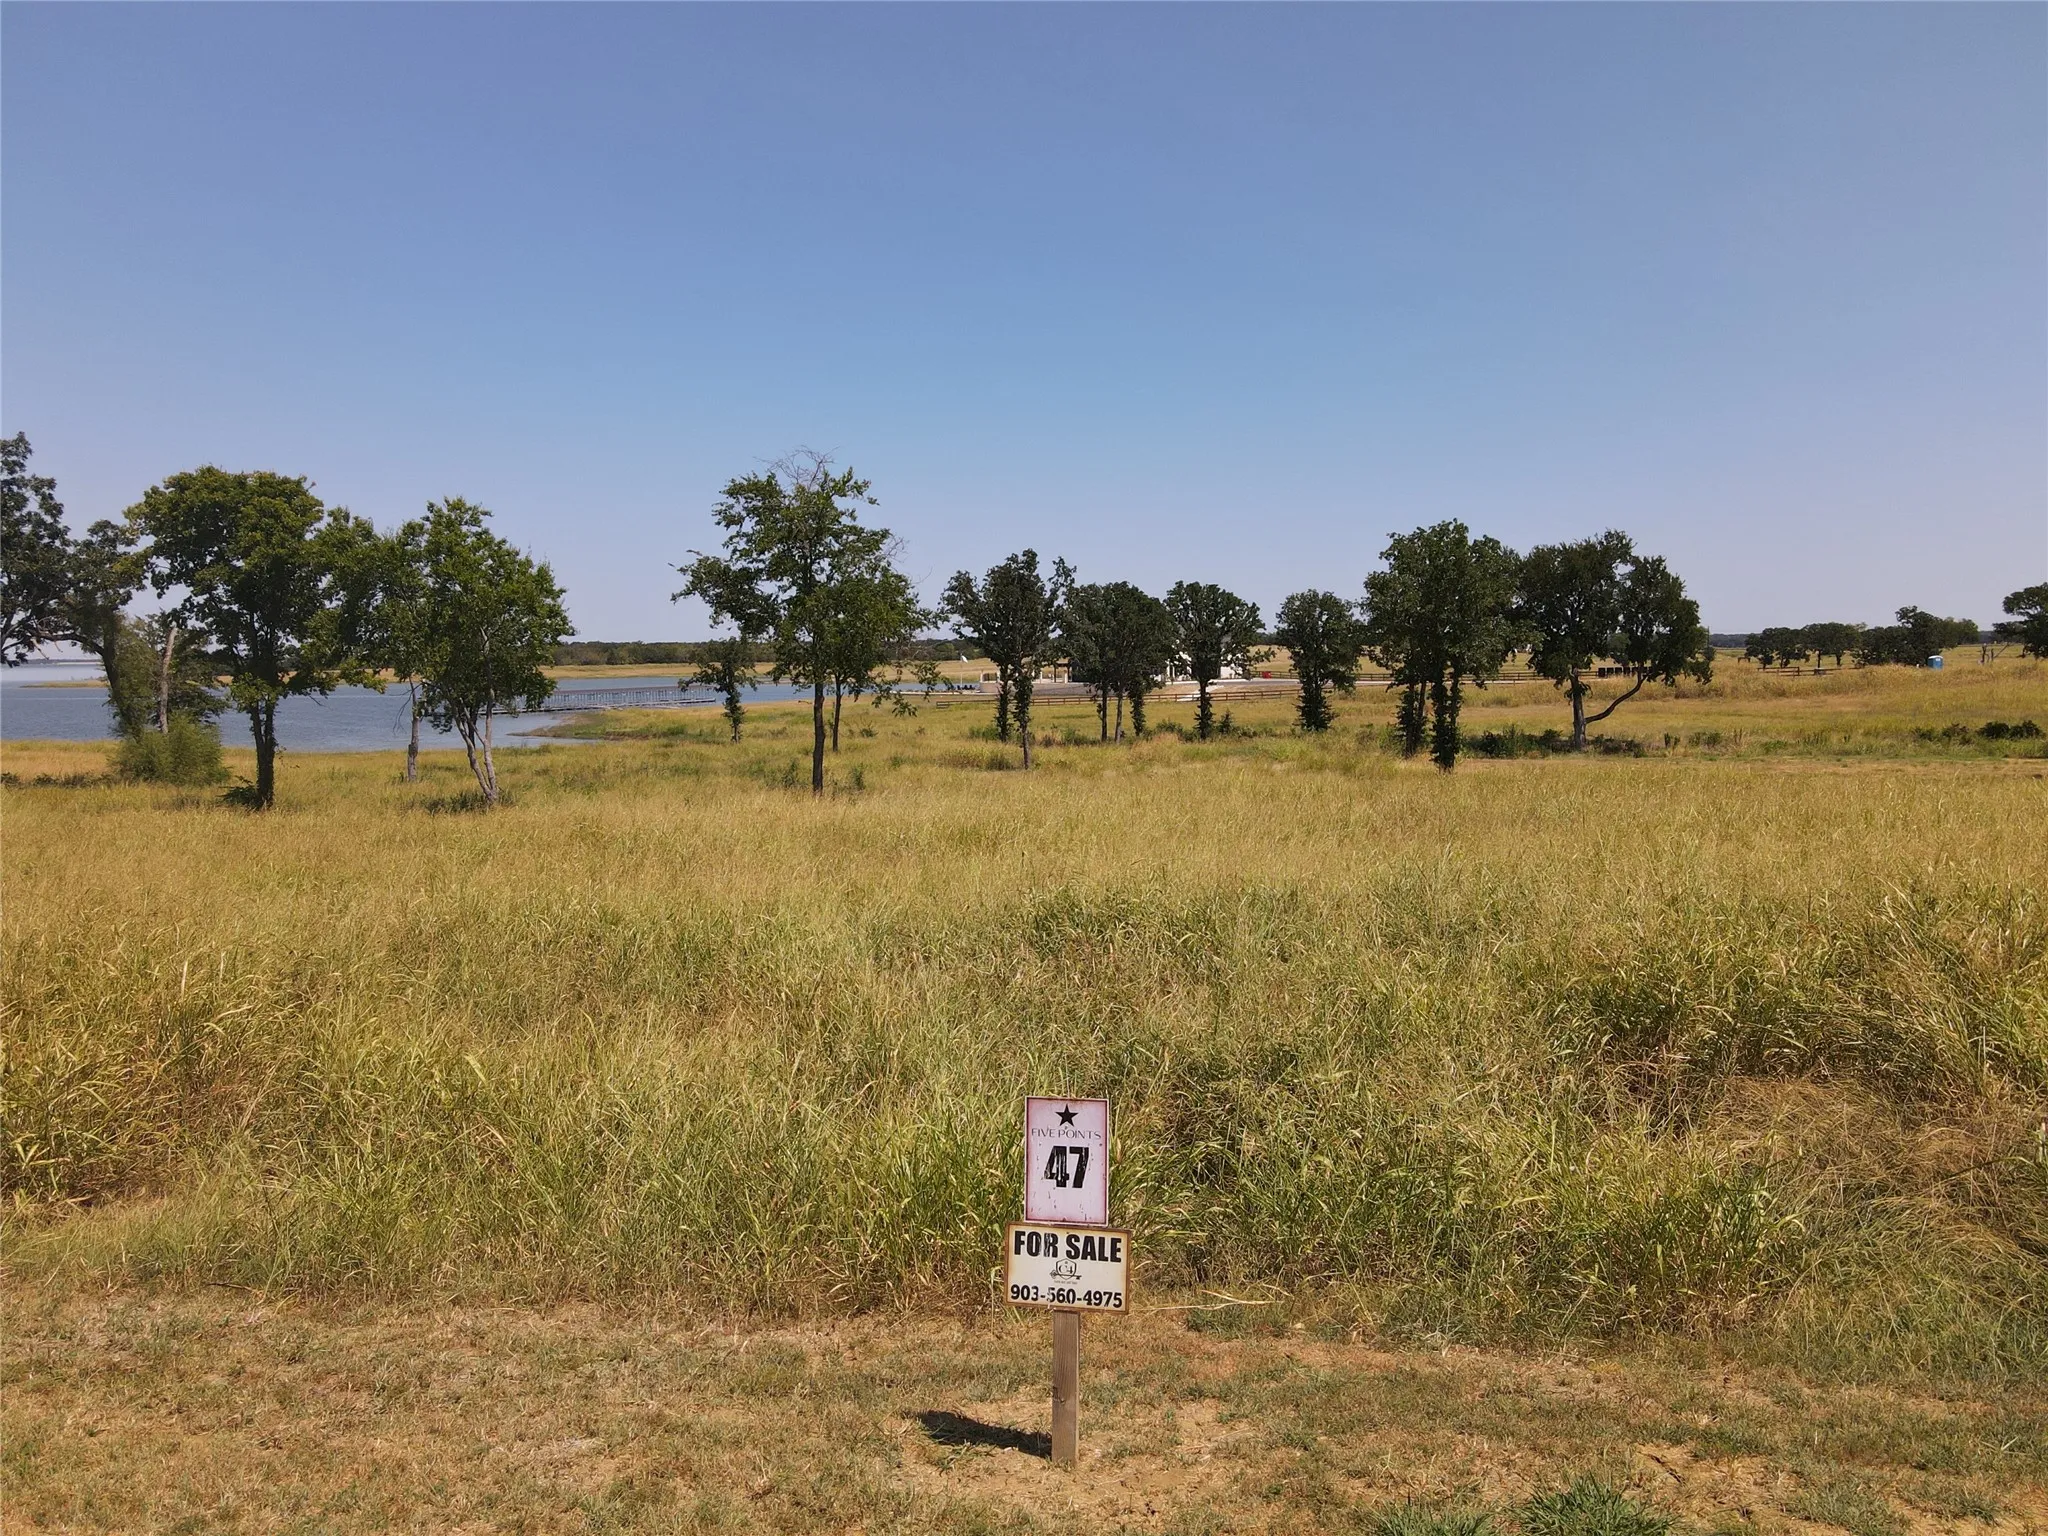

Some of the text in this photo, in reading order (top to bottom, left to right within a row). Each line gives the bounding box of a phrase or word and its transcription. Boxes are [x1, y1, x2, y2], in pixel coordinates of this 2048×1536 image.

[1031, 1128, 1102, 1139] FIVE POINTS
[1044, 1146, 1089, 1188] 47
[1014, 1230, 1122, 1263] FOR SALE
[1010, 1284, 1122, 1308] 903-560-4975
